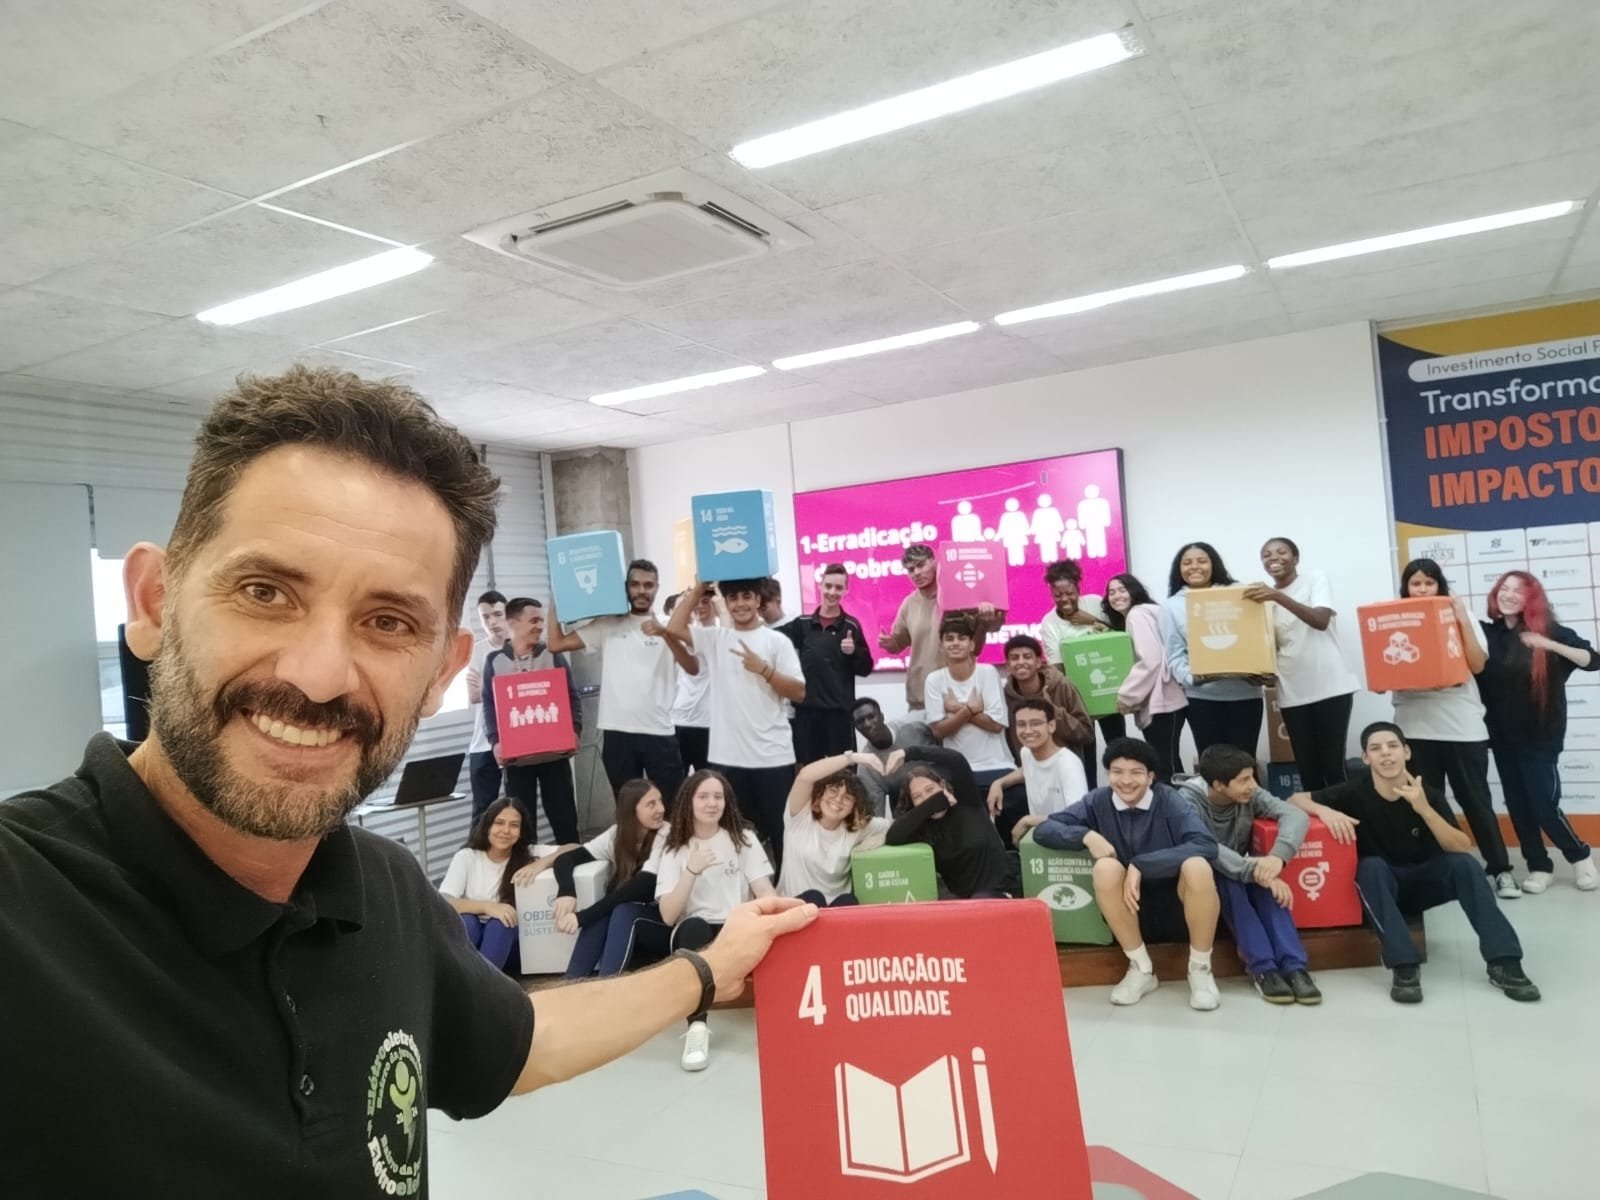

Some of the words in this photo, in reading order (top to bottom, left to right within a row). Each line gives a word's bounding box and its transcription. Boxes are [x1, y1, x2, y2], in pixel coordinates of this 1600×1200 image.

[1427, 352, 1533, 376] Investimento
[1536, 340, 1588, 361] Social
[700, 508, 713, 523] 14
[945, 548, 957, 562] 10
[506, 685, 513, 699] 1
[1029, 857, 1044, 875] 13
[864, 871, 874, 889] 3
[523, 910, 553, 921] OBJE
[797, 964, 827, 1026] 4
[843, 953, 941, 986] EDUCAÇÃO
[942, 957, 967, 983] DE
[845, 990, 952, 1022] QUALIDADE
